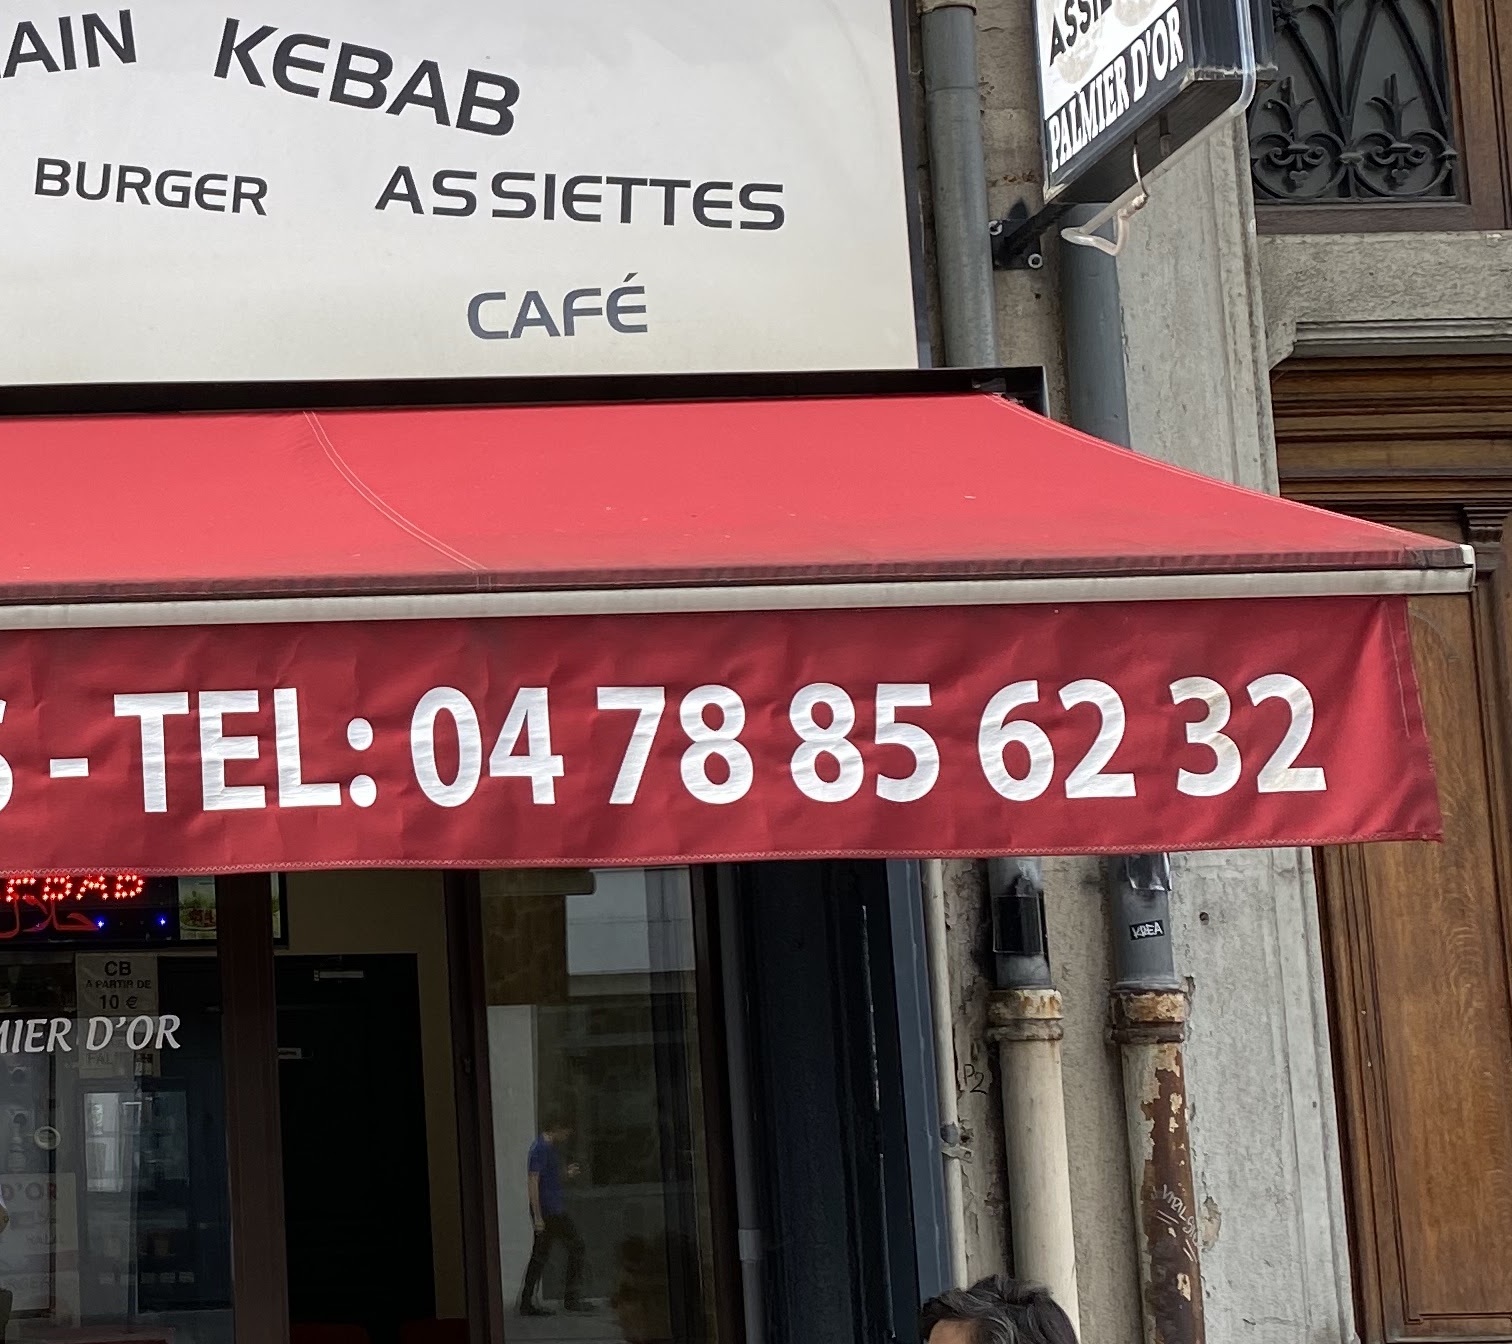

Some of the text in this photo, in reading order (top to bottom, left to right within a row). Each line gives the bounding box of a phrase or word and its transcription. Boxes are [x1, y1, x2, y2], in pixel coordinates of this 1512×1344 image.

[214, 16, 522, 137] KEBAB
[1048, 12, 1185, 173] PALMIER D'OR
[33, 157, 269, 216] BURGER
[374, 164, 787, 232] ASSIETTES
[466, 271, 649, 340] CAFÉ
[113, 687, 378, 813] TEL:
[409, 685, 565, 808] 04
[596, 683, 755, 806] 78
[788, 681, 941, 803] 85
[976, 679, 1139, 802] 62
[1168, 672, 1328, 799] 32
[95, 979, 134, 989] PARTIR
[137, 979, 152, 989] DE
[104, 960, 132, 976] CB
[85, 1014, 181, 1051] D'OR
[99, 994, 138, 1009] 10 €
